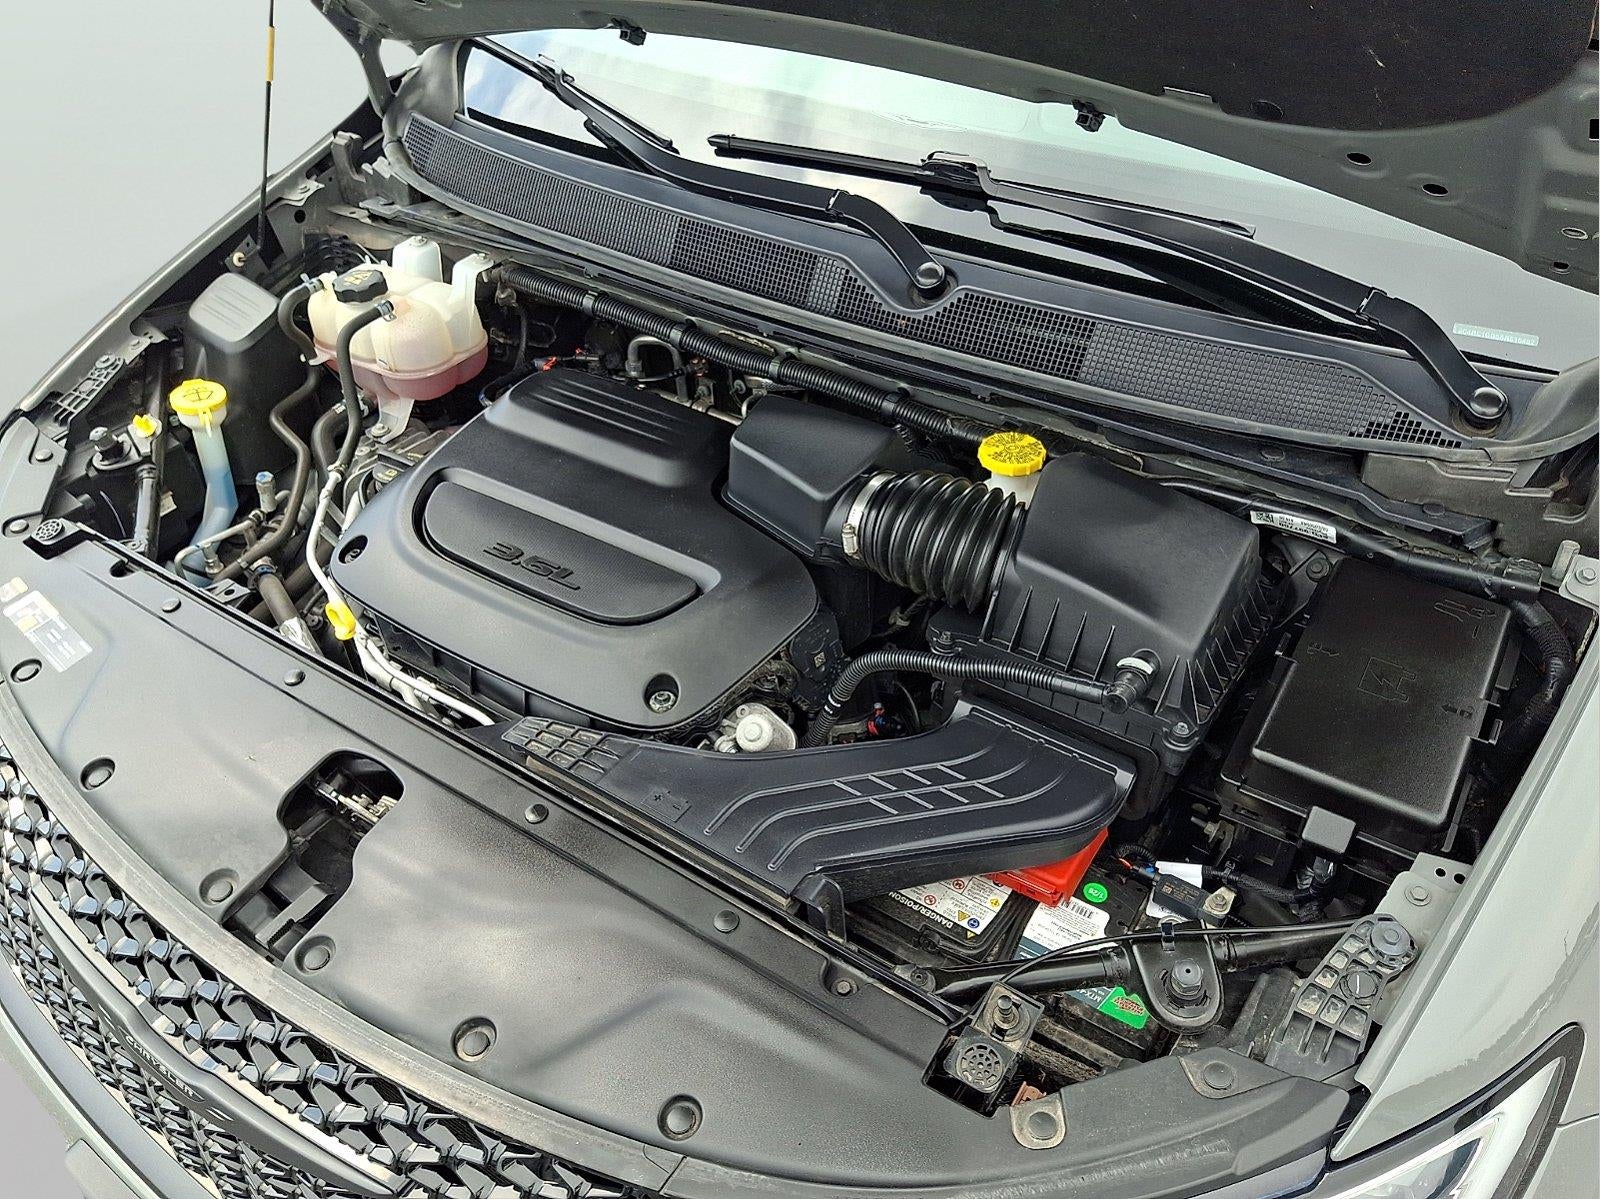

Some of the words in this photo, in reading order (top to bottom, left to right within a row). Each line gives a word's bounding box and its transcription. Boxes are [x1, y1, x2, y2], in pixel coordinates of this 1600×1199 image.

[483, 542, 581, 591] 3.6L
[888, 890, 954, 929] DANGER/POISON
[1076, 988, 1102, 1003] MTX-4
[125, 1035, 195, 1098] CHRYSLER
